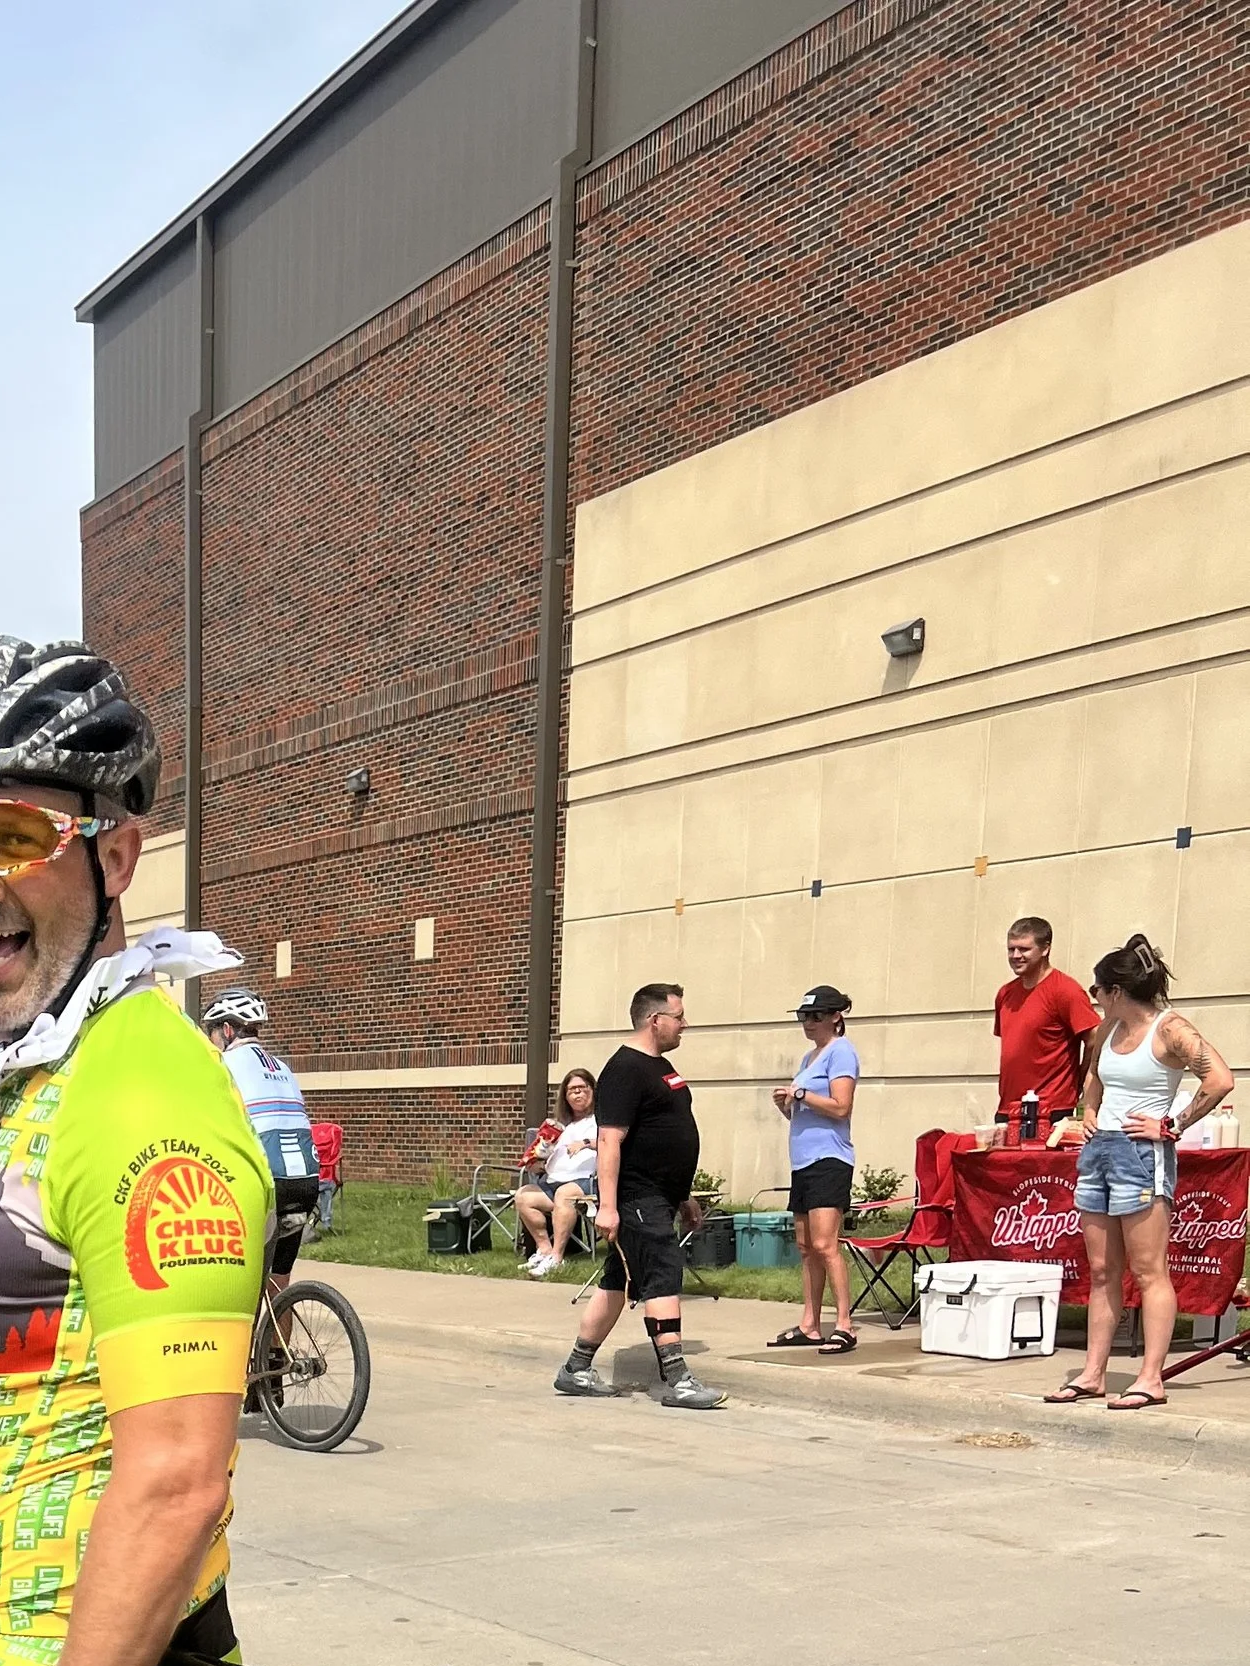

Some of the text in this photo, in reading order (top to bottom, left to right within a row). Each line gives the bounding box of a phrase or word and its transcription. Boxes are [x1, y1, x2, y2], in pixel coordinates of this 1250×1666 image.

[114, 1139, 236, 1205] CKF BIKE TEAM 2024
[1055, 1176, 1075, 1191] SYRU
[156, 1219, 241, 1239] CHRIS
[992, 1206, 1083, 1250] Untappe
[158, 1238, 244, 1259] KLUG
[159, 1257, 245, 1270] FOUNDATION
[1168, 1264, 1221, 1275] THLETIC FUEL
[1181, 1255, 1221, 1265] NATURAL
[163, 1341, 218, 1356] PRIMAL
[41, 1505, 66, 1538] LIFE
[15, 1519, 37, 1549] LIFE
